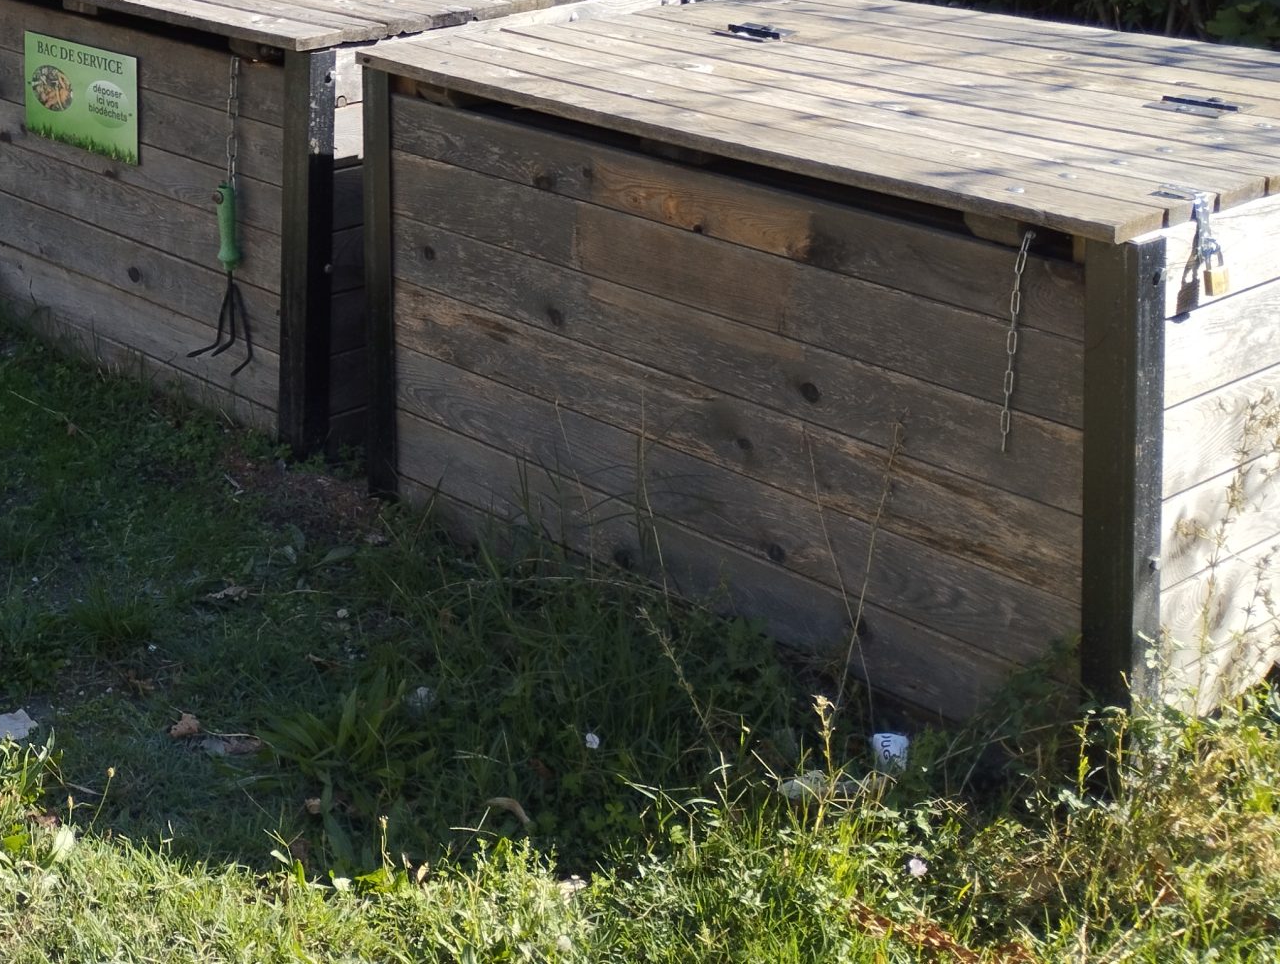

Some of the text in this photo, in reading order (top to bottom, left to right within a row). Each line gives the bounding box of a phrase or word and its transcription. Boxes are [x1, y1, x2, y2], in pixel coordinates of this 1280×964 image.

[37, 40, 123, 74] BAC DE SERVICE
[92, 83, 123, 99] déposer
[96, 96, 119, 109] ici vos
[88, 103, 128, 123] biodéchets
